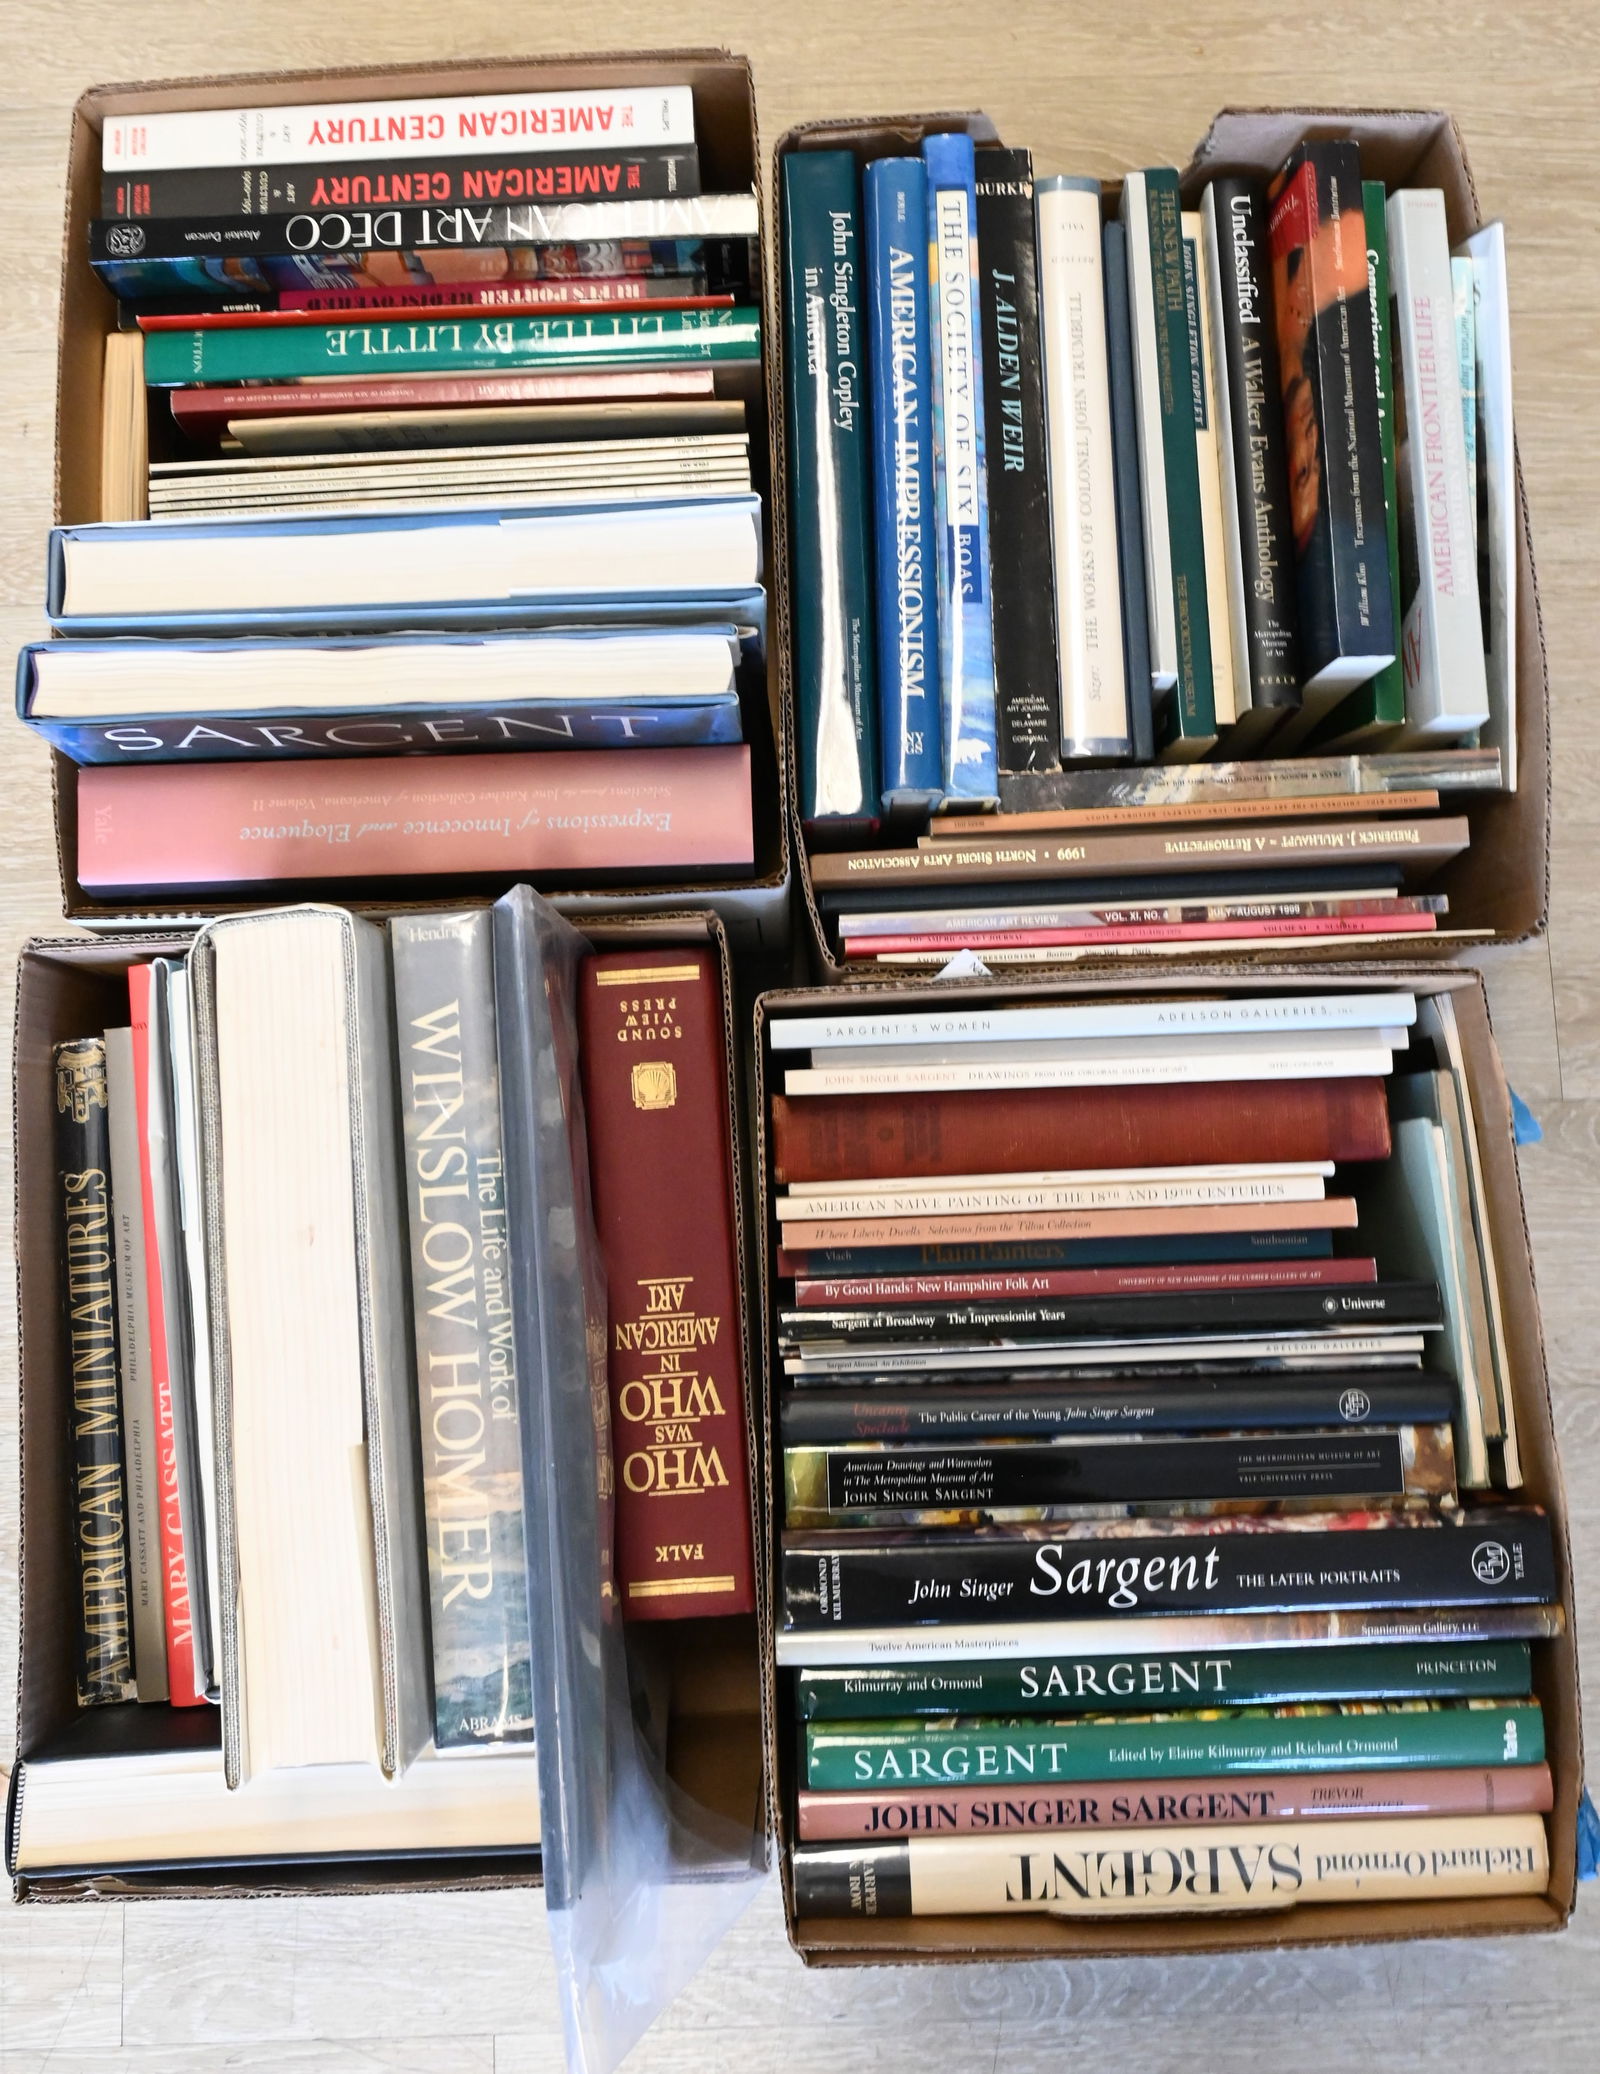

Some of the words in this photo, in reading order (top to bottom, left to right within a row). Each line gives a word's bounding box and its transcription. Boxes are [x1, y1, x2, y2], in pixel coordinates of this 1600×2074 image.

[307, 112, 445, 146] CENTURY
[458, 104, 614, 138] AMERICAN
[286, 182, 296, 204] ART
[310, 171, 451, 206] CENTURY
[463, 164, 621, 199] AMERICAN
[626, 164, 641, 189] THE
[285, 210, 403, 250] DECO
[415, 207, 492, 244] ART
[828, 210, 853, 257] John
[942, 201, 963, 259] THE
[1230, 194, 1261, 324] Unclassified
[992, 267, 1015, 289] J.
[830, 262, 857, 356] Singleton
[1414, 296, 1432, 345] LIFE
[325, 324, 461, 357] LITTLE
[473, 321, 514, 355] BY
[528, 315, 665, 342] LITTLE
[888, 245, 918, 427] AMERICAN
[944, 271, 970, 398] SOCIETY
[996, 294, 1021, 391] ALDEN
[1242, 336, 1261, 353] A
[834, 360, 857, 433] Copley
[1244, 357, 1267, 429] Walker
[1419, 346, 1444, 463] FRONTIER
[953, 413, 971, 452] OF
[1001, 400, 1025, 472] WEIR
[1249, 433, 1270, 493] Evans
[954, 463, 973, 514] SIX
[1427, 470, 1454, 598] AMERICAN
[1253, 498, 1279, 605] Anthology
[893, 439, 925, 700] IMPRESSIONISM
[1006, 705, 1019, 713] ART
[1020, 704, 1050, 713] JOURNAL
[1010, 696, 1045, 704] AMERICAN
[104, 714, 658, 750] SARGENT
[1011, 719, 1048, 727] DELAWARE
[94, 803, 113, 845] Yale
[239, 819, 352, 843] Eloquence
[403, 813, 511, 837] Innocence
[516, 808, 541, 831] of
[547, 807, 672, 833] Expressions
[1057, 846, 1086, 861] 1999
[1165, 837, 1252, 854] RETROSPECTIVE
[1255, 838, 1266, 850] A
[1281, 832, 1344, 848] MULHAUPT
[1346, 832, 1357, 847] J.
[1359, 829, 1420, 846] FREDERICK
[848, 855, 920, 871] ASSOCIATION
[924, 853, 953, 868] ARTS
[956, 851, 993, 866] SHORE
[996, 849, 1037, 864] NORTH
[619, 997, 677, 1013] PRESS
[625, 1011, 674, 1027] VIEW
[617, 1025, 683, 1042] SOUND
[826, 1024, 919, 1037] SARGENT'S
[929, 1020, 992, 1033] WOMEN
[409, 999, 479, 1331] WINSLOW
[475, 1148, 505, 1202] The
[804, 1200, 887, 1213] AMERICAN
[893, 1197, 942, 1210] NAIVE
[947, 1195, 1022, 1208] PAINTING
[1027, 1192, 1044, 1204] OF
[1055, 1191, 1088, 1203] THE
[1127, 1189, 1158, 1202] AND
[1197, 1184, 1286, 1198] CENTURIES
[123, 1214, 131, 1234] ART
[478, 1208, 507, 1262] Life
[815, 1228, 850, 1240] Where
[852, 1226, 885, 1240] Liberty
[888, 1224, 922, 1237] Dwells
[927, 1223, 973, 1236] Selections
[974, 1221, 997, 1236] from
[998, 1221, 1014, 1233] the
[1047, 1218, 1092, 1231] Collection
[125, 1240, 133, 1254] OF
[125, 1257, 134, 1300] MUSEUM
[482, 1266, 510, 1316] and
[824, 1284, 840, 1298] By
[842, 1282, 873, 1296] Good
[875, 1281, 914, 1295] Hands:
[916, 1281, 941, 1293] New
[943, 1279, 1003, 1295] Hampshire
[1005, 1278, 1029, 1291] Folk
[1031, 1277, 1050, 1290] Art
[63, 1166, 119, 1440] MINIATURES
[645, 1283, 686, 1313] ART
[831, 1318, 870, 1332] Sargent
[872, 1317, 883, 1328] at
[885, 1314, 936, 1329] Broadway
[946, 1313, 967, 1325] The
[969, 1310, 1036, 1325] Impressionist
[1039, 1309, 1066, 1321] Years
[1341, 1297, 1386, 1310] Universe
[126, 1303, 138, 1383] PHILADELPHIA
[615, 1316, 720, 1350] AMERICAN
[488, 1320, 517, 1393] Work
[660, 1354, 682, 1372] IN
[491, 1396, 518, 1424] of
[619, 1375, 726, 1422] WHO
[918, 1412, 937, 1424] The
[939, 1410, 969, 1423] Public
[970, 1410, 1001, 1422] Career
[1003, 1409, 1014, 1420] of
[1015, 1409, 1030, 1420] the
[1031, 1408, 1062, 1423] Young
[1064, 1406, 1087, 1422] John
[1089, 1406, 1119, 1420] Singer
[1120, 1404, 1155, 1419] Sargent
[655, 1423, 694, 1444] WAS
[157, 1383, 184, 1536] CASSATT
[622, 1446, 730, 1493] WHO
[843, 1460, 884, 1473] American
[886, 1459, 926, 1474] Drawings
[928, 1459, 945, 1471] and
[946, 1457, 993, 1470] Watercolors
[427, 1349, 494, 1611] HOMER
[843, 1474, 852, 1486] in
[854, 1474, 870, 1486] The
[873, 1472, 927, 1487] Metropolitan
[929, 1472, 967, 1485] Museum
[969, 1471, 979, 1485] of
[979, 1471, 994, 1482] Art
[842, 1491, 878, 1506] JOHN
[883, 1489, 930, 1502] SINGER
[935, 1487, 994, 1500] SARGENT
[655, 1543, 705, 1563] FALK
[1512, 1541, 1523, 1581] YALE
[77, 1461, 131, 1688] AMERICAN
[818, 1557, 828, 1615] ORMOND
[832, 1554, 841, 1621] KILMURRAY
[907, 1579, 951, 1606] John
[959, 1577, 1014, 1602] Singer
[1029, 1543, 1220, 1609] Sargent
[1235, 1573, 1266, 1588] THE
[1270, 1570, 1313, 1587] LATER
[1319, 1568, 1401, 1586] PORTRAITS
[161, 1545, 195, 1649] MARY
[869, 1641, 903, 1653] Twelve
[904, 1640, 952, 1651] American
[954, 1637, 1020, 1652] Masterpieces
[844, 1678, 902, 1696] Kilmurray
[906, 1677, 928, 1691] and
[930, 1675, 983, 1691] Ormond
[1019, 1659, 1232, 1698] SARGENT
[1416, 1658, 1498, 1676] PRINCETON
[854, 1743, 1068, 1780] SARGENT
[1108, 1747, 1147, 1763] Edited
[1150, 1747, 1165, 1763] by
[1168, 1745, 1204, 1760] Elaine
[1208, 1743, 1267, 1761] Kilmurray
[1270, 1741, 1292, 1757] and
[1295, 1738, 1343, 1755] Richard
[1346, 1737, 1398, 1754] Ormond
[1311, 1786, 1365, 1801] TREVOR
[865, 1801, 958, 1832] JOHN
[970, 1798, 1099, 1828] SINGER
[1111, 1790, 1275, 1823] SARGENT
[1006, 1843, 1302, 1902] SARGENT
[1316, 1847, 1426, 1880] Ormond
[1431, 1844, 1536, 1878] Richard
